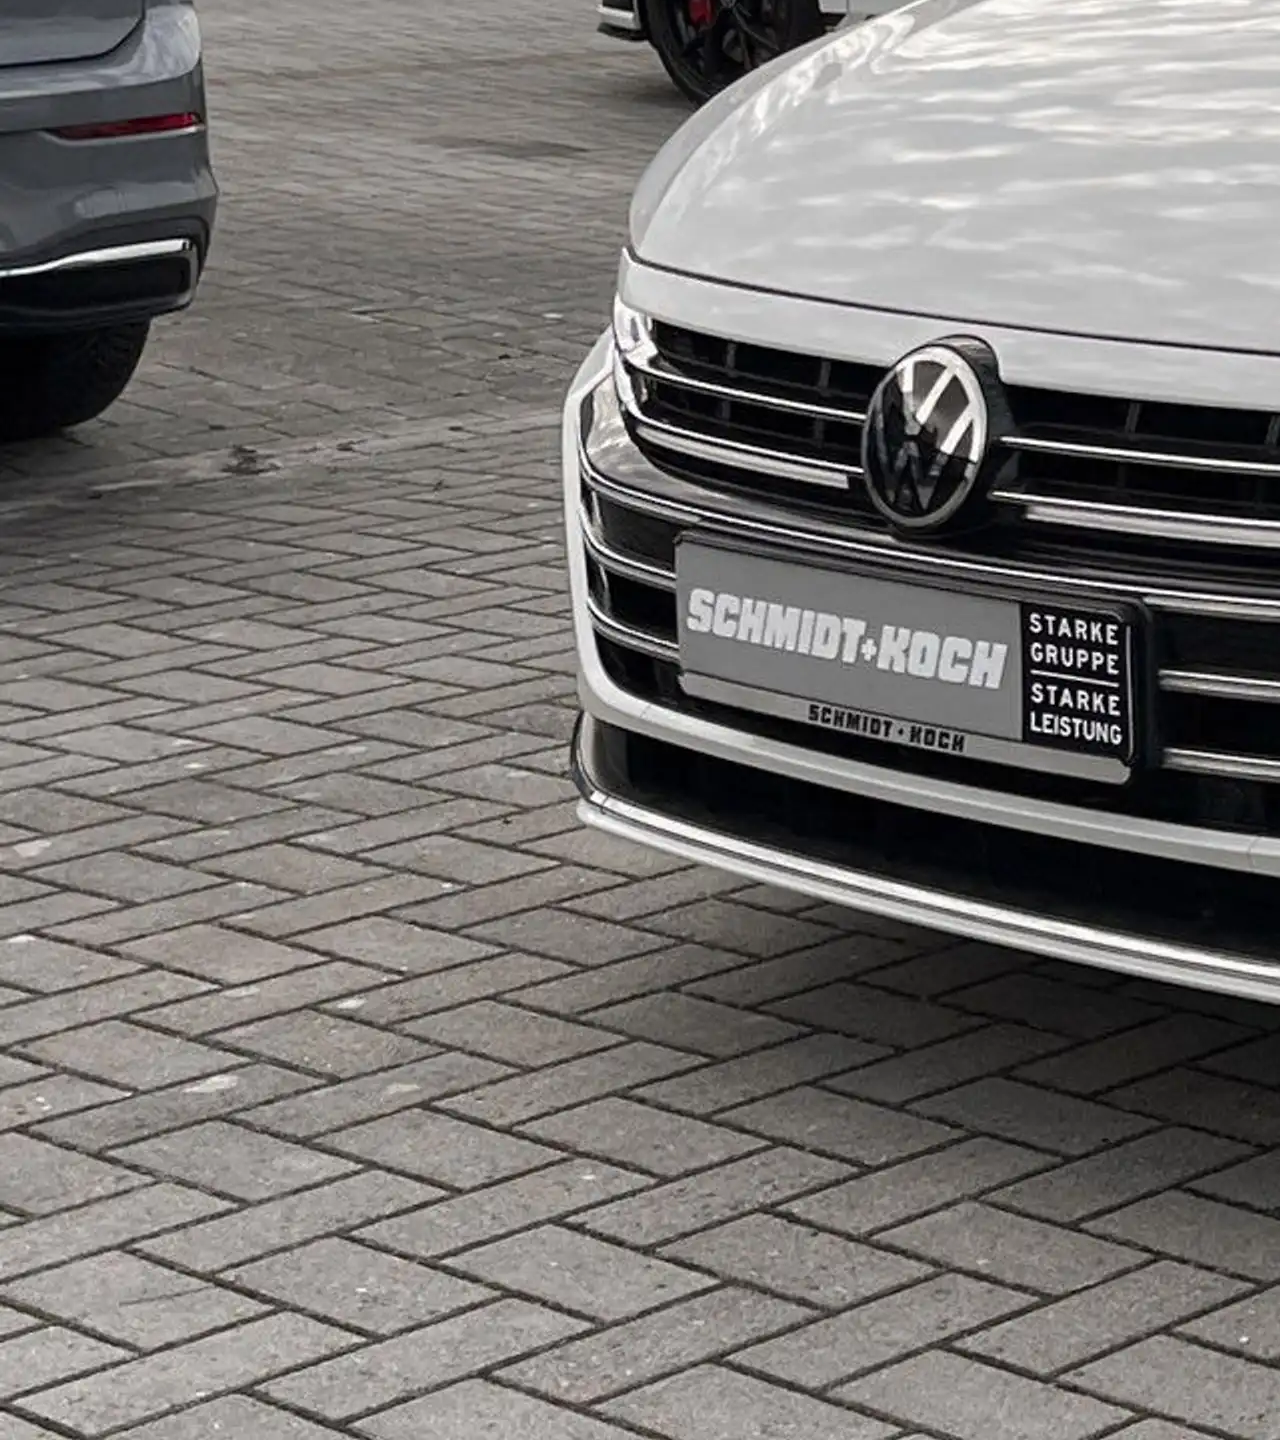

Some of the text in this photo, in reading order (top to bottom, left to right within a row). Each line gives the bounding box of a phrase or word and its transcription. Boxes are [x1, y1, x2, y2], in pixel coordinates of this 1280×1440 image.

[1029, 612, 1119, 645] STARKE
[1030, 642, 1120, 675] GRUPPE
[1031, 682, 1121, 716] STARKE
[808, 704, 966, 753] SCHMIDT KOCH
[1030, 711, 1123, 745] LEISTUNG
